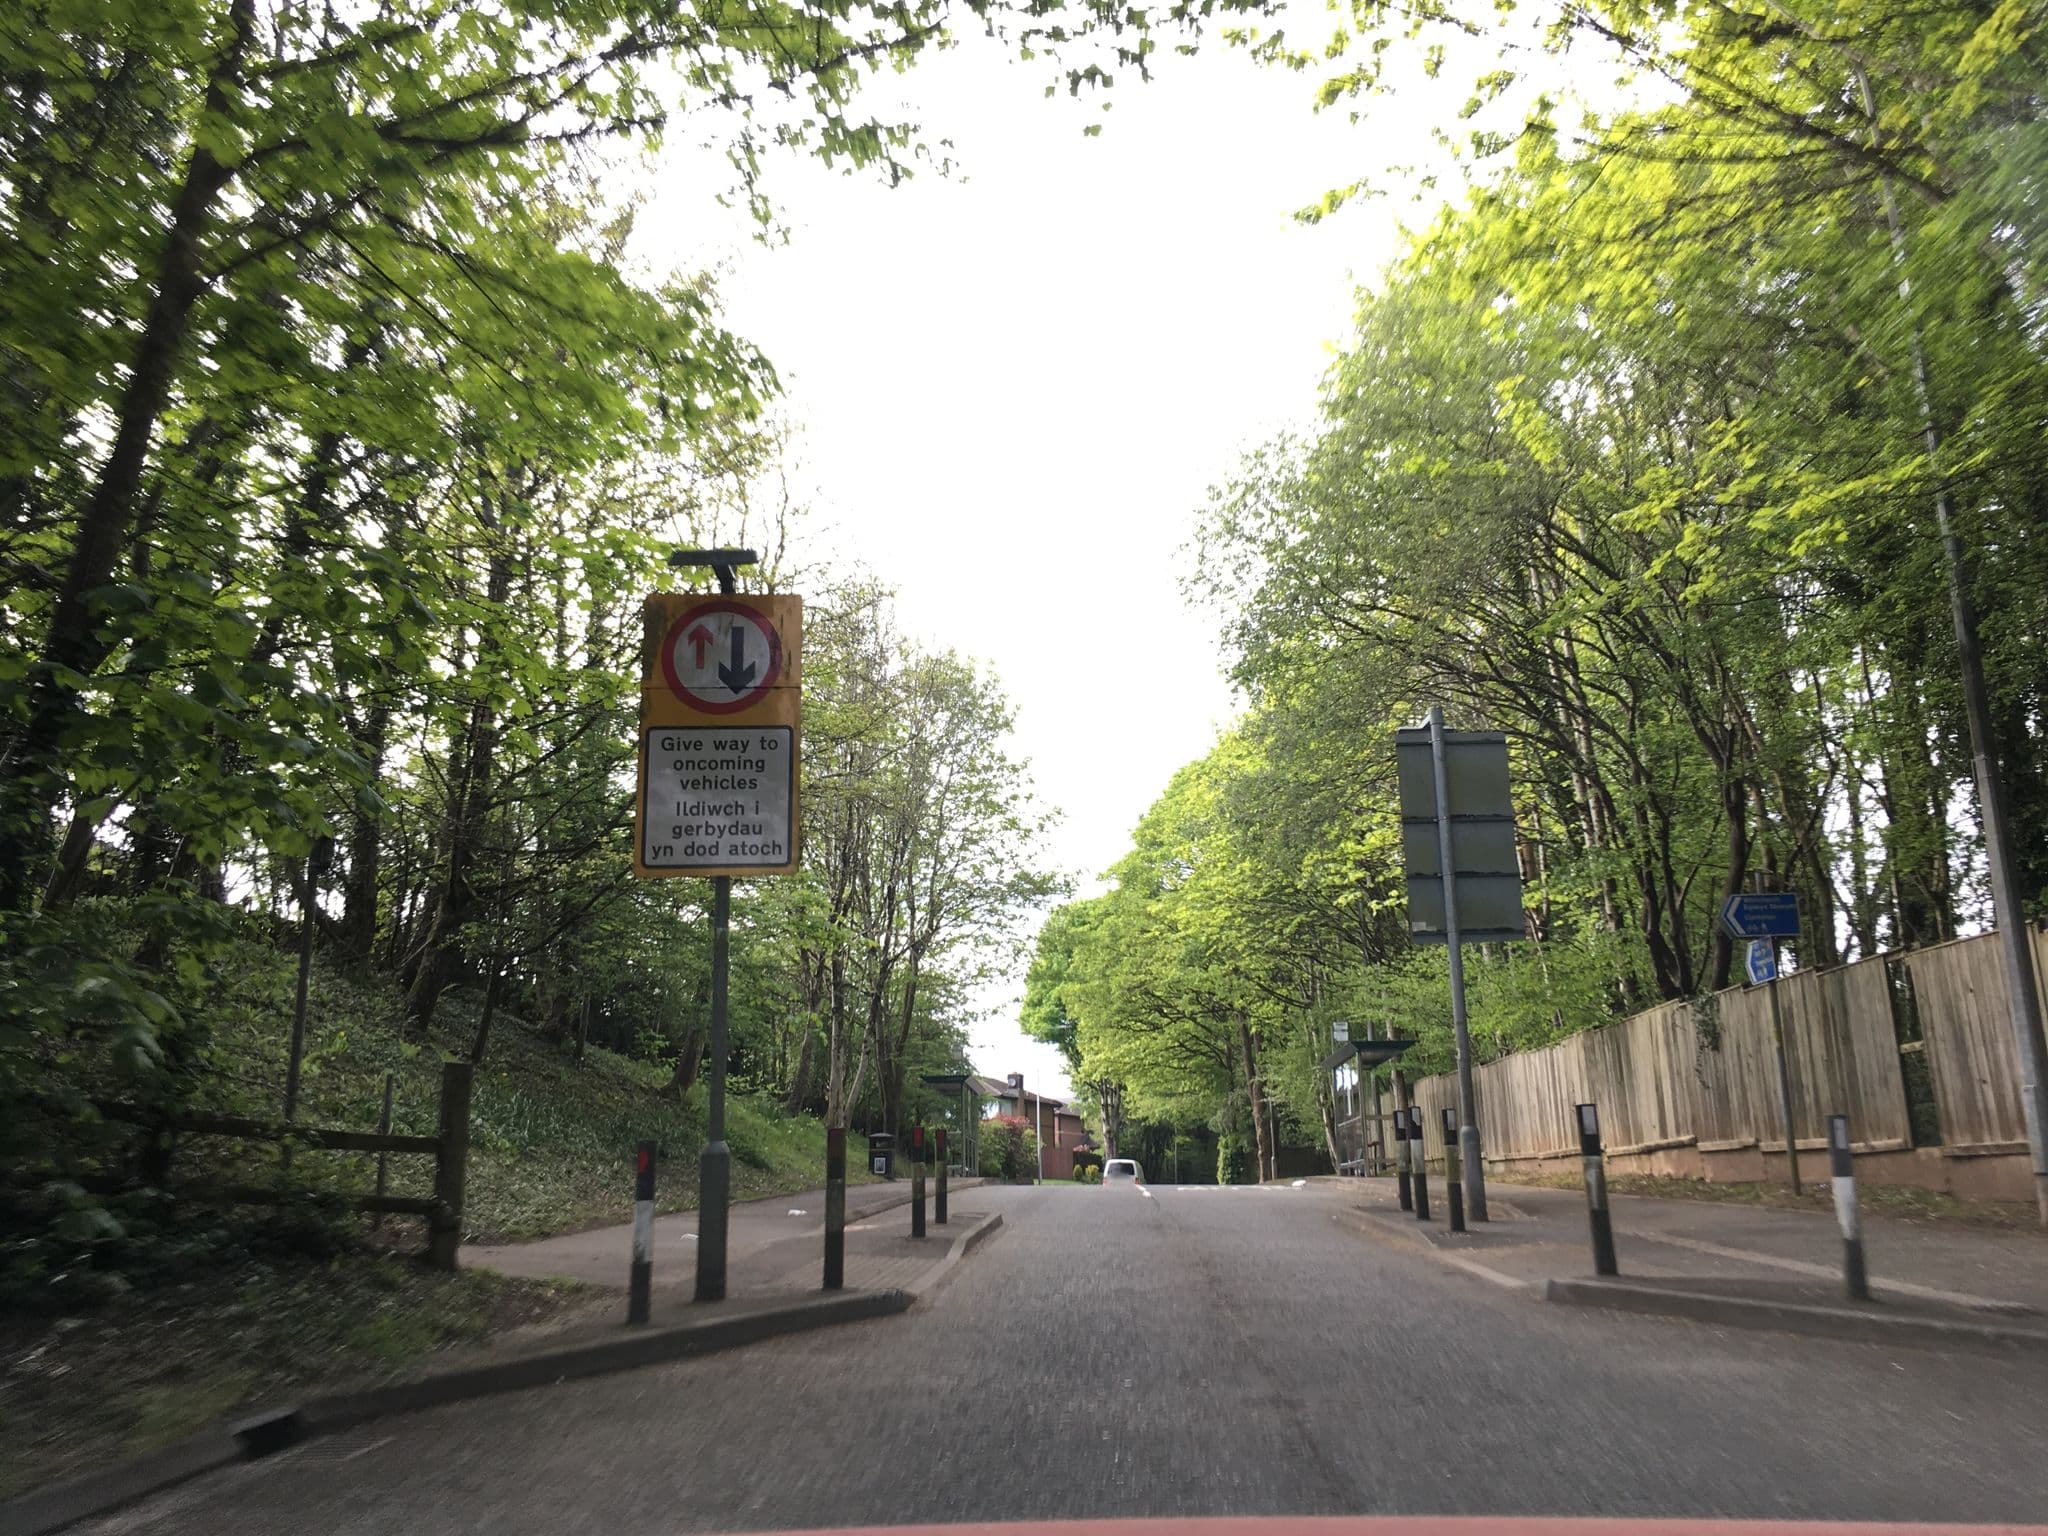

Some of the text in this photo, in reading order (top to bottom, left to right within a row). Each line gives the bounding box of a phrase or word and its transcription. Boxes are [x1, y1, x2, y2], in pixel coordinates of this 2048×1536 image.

[661, 736, 779, 753] Give way to
[673, 755, 765, 773] oncoming
[680, 774, 758, 790] vehicles
[676, 801, 760, 816] Ildiwch i
[672, 821, 762, 839] gerbydau
[651, 840, 782, 860] yn dod atoch
